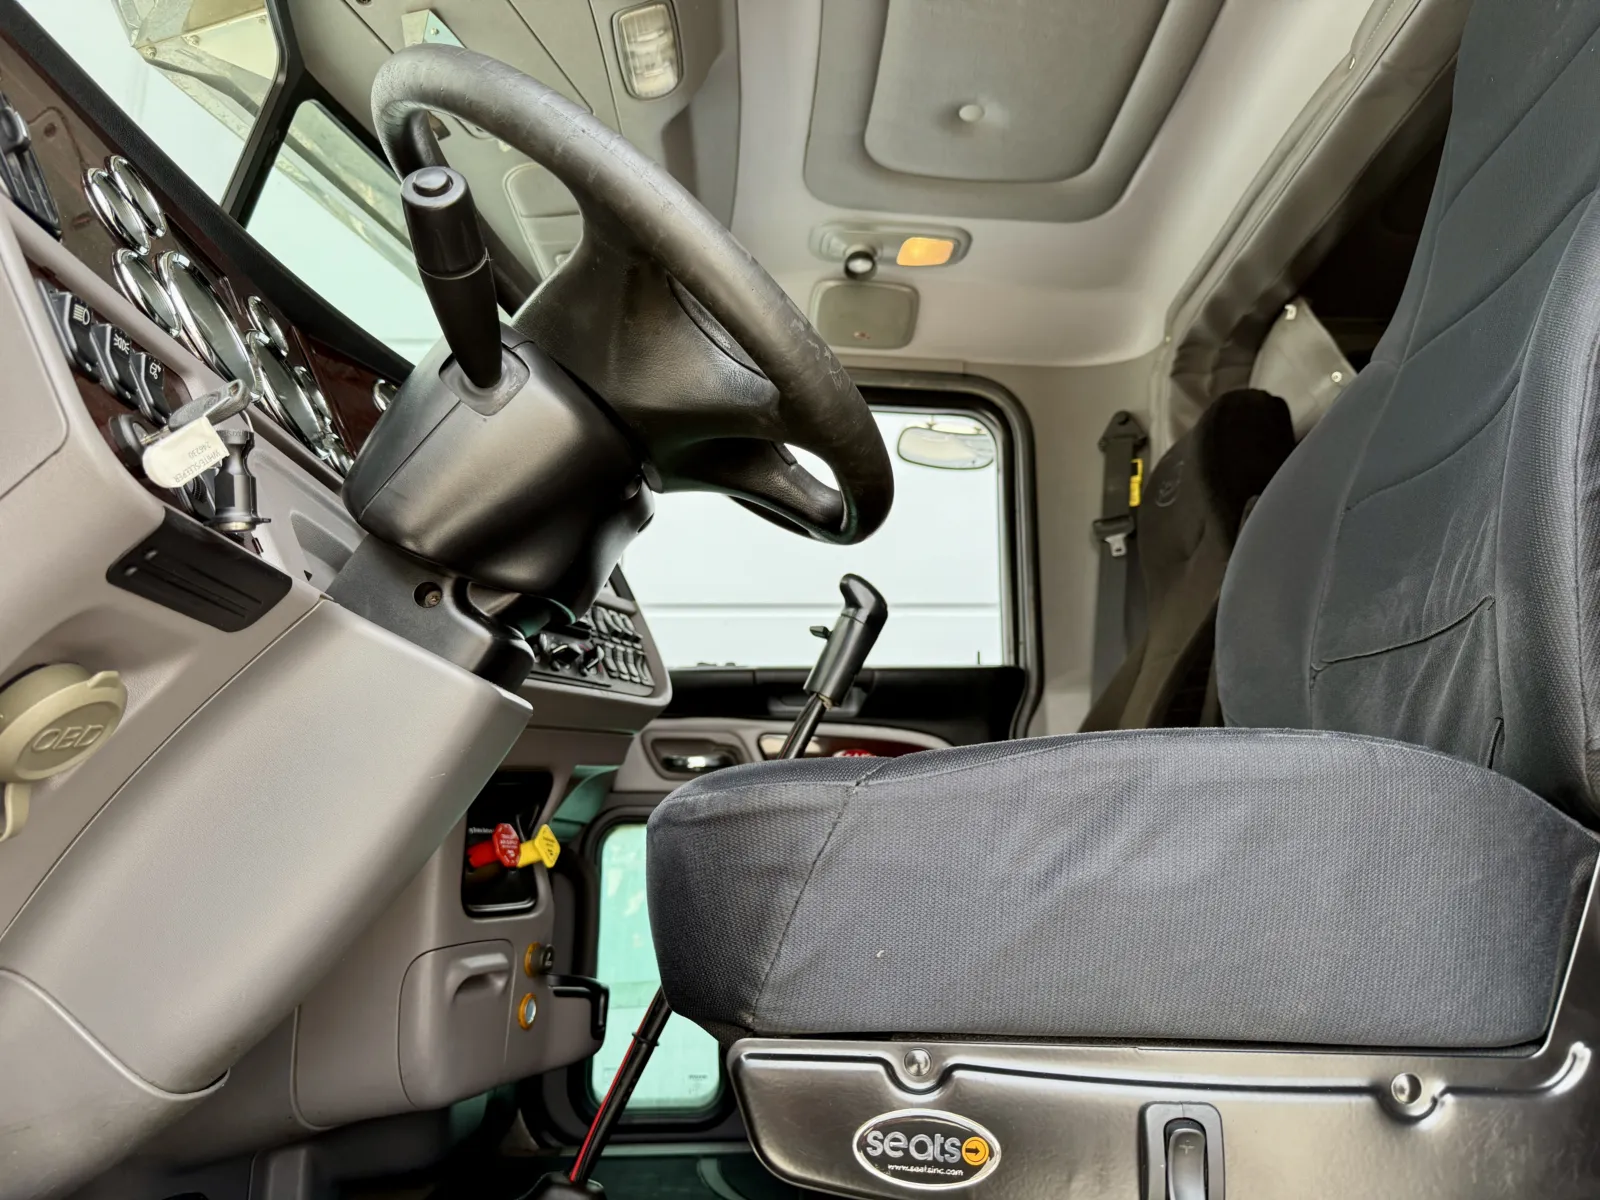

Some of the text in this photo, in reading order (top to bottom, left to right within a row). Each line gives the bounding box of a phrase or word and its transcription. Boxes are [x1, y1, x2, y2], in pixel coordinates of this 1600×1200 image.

[32, 724, 104, 751] OBD
[866, 1130, 962, 1163] seats
[887, 1163, 964, 1177] www.seatsinc.com
